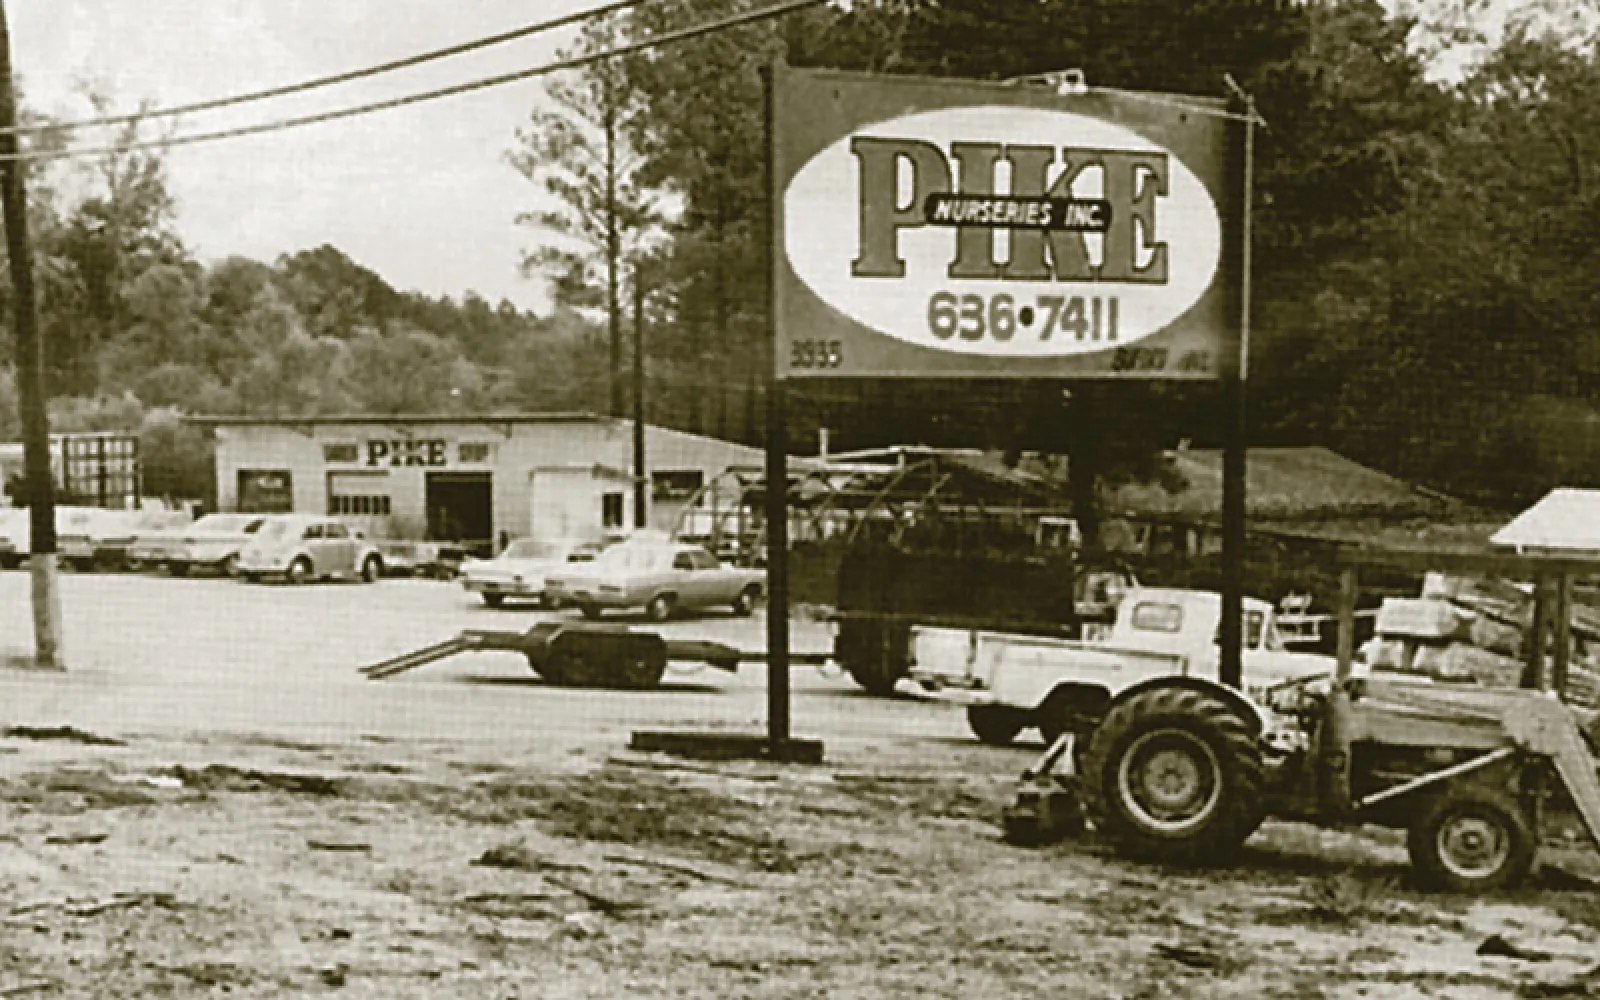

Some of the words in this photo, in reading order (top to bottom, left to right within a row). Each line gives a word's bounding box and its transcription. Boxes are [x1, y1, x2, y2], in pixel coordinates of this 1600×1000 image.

[850, 137, 1168, 284] PIKE
[932, 199, 1052, 226] NURSERIES
[366, 439, 447, 467] PIKE
